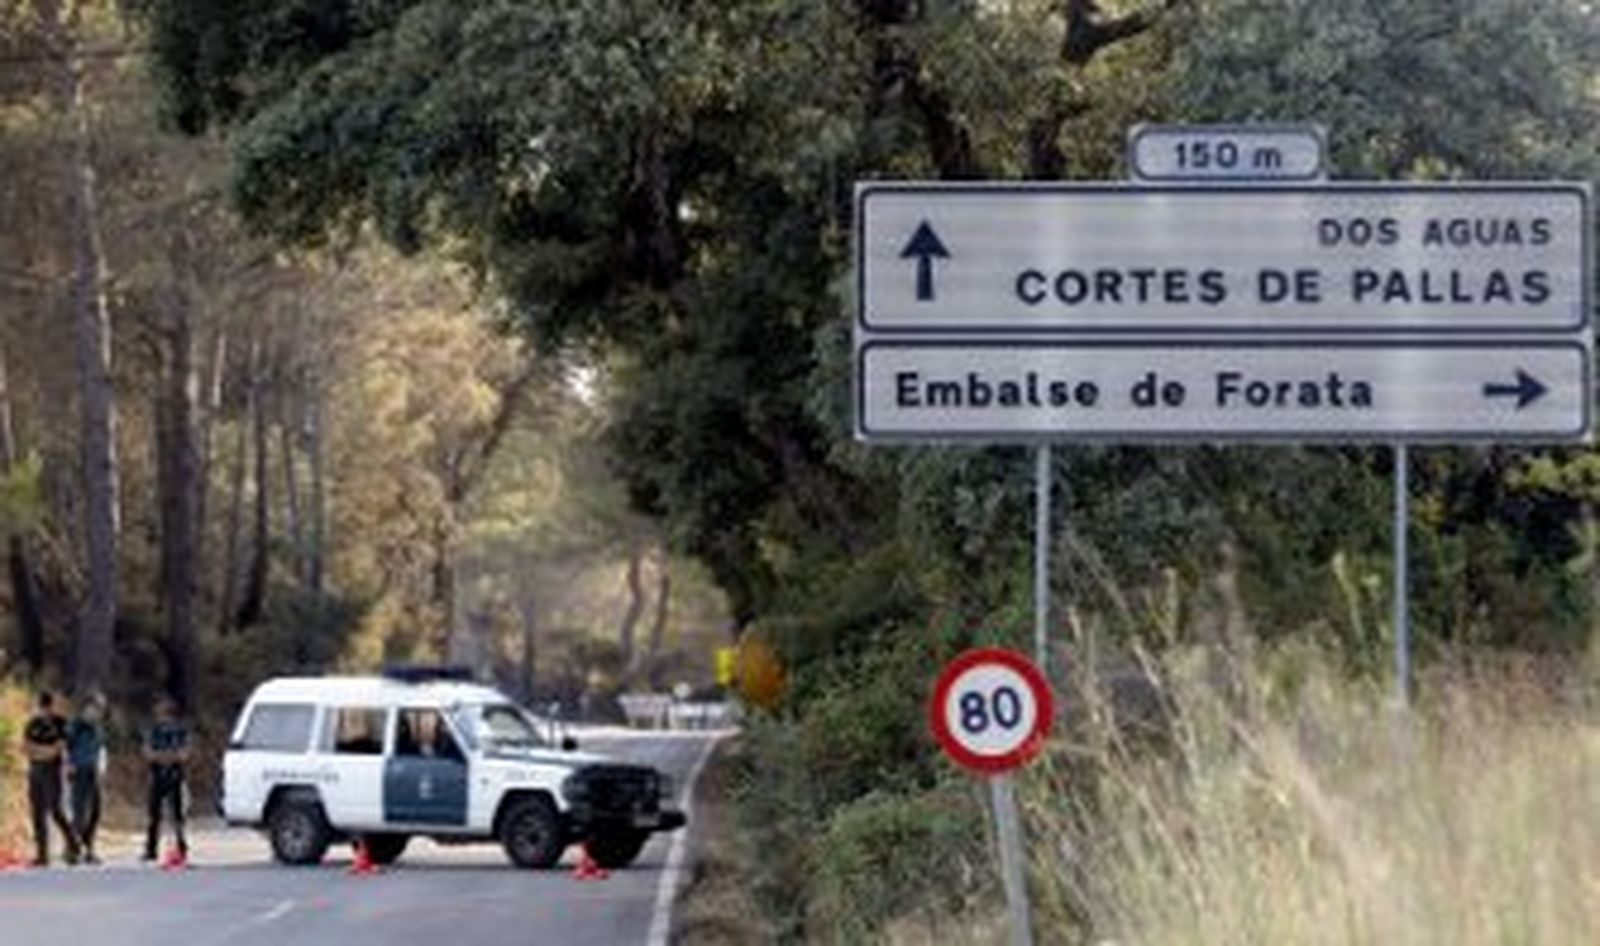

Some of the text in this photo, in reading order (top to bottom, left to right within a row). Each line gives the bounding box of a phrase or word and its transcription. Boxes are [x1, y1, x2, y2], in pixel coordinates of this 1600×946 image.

[1174, 141, 1283, 171] 150 m
[1318, 218, 1552, 247] DOS AGUAS
[1014, 268, 1552, 306] CORTES DE PALLAS
[895, 371, 1373, 409] Embalse de Forata
[959, 686, 1022, 733] 80
